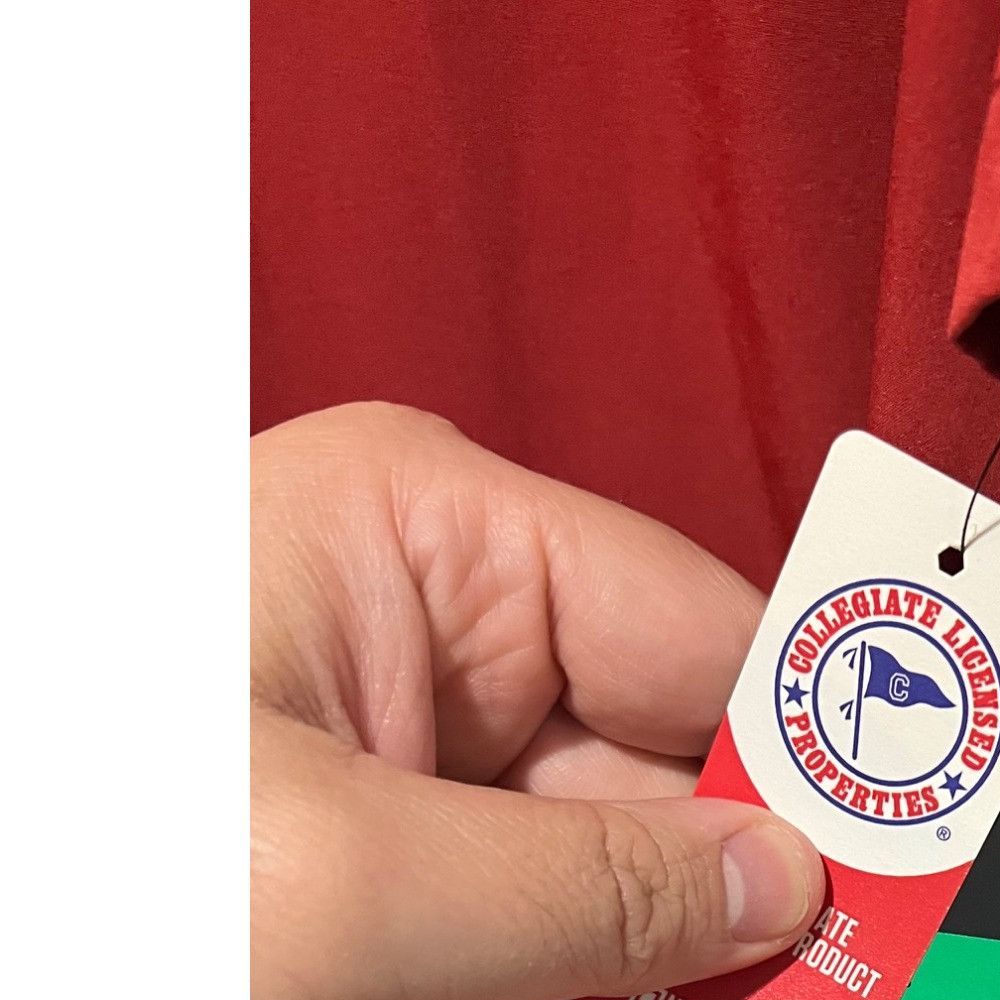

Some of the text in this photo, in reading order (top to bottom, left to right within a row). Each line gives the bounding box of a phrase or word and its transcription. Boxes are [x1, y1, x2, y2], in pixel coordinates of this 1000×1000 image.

[785, 587, 999, 818] COLLEGIATE LICENSED PROPERTIES
[889, 672, 910, 701] C
[813, 906, 860, 948] ATE
[792, 931, 883, 998] RODUCT
